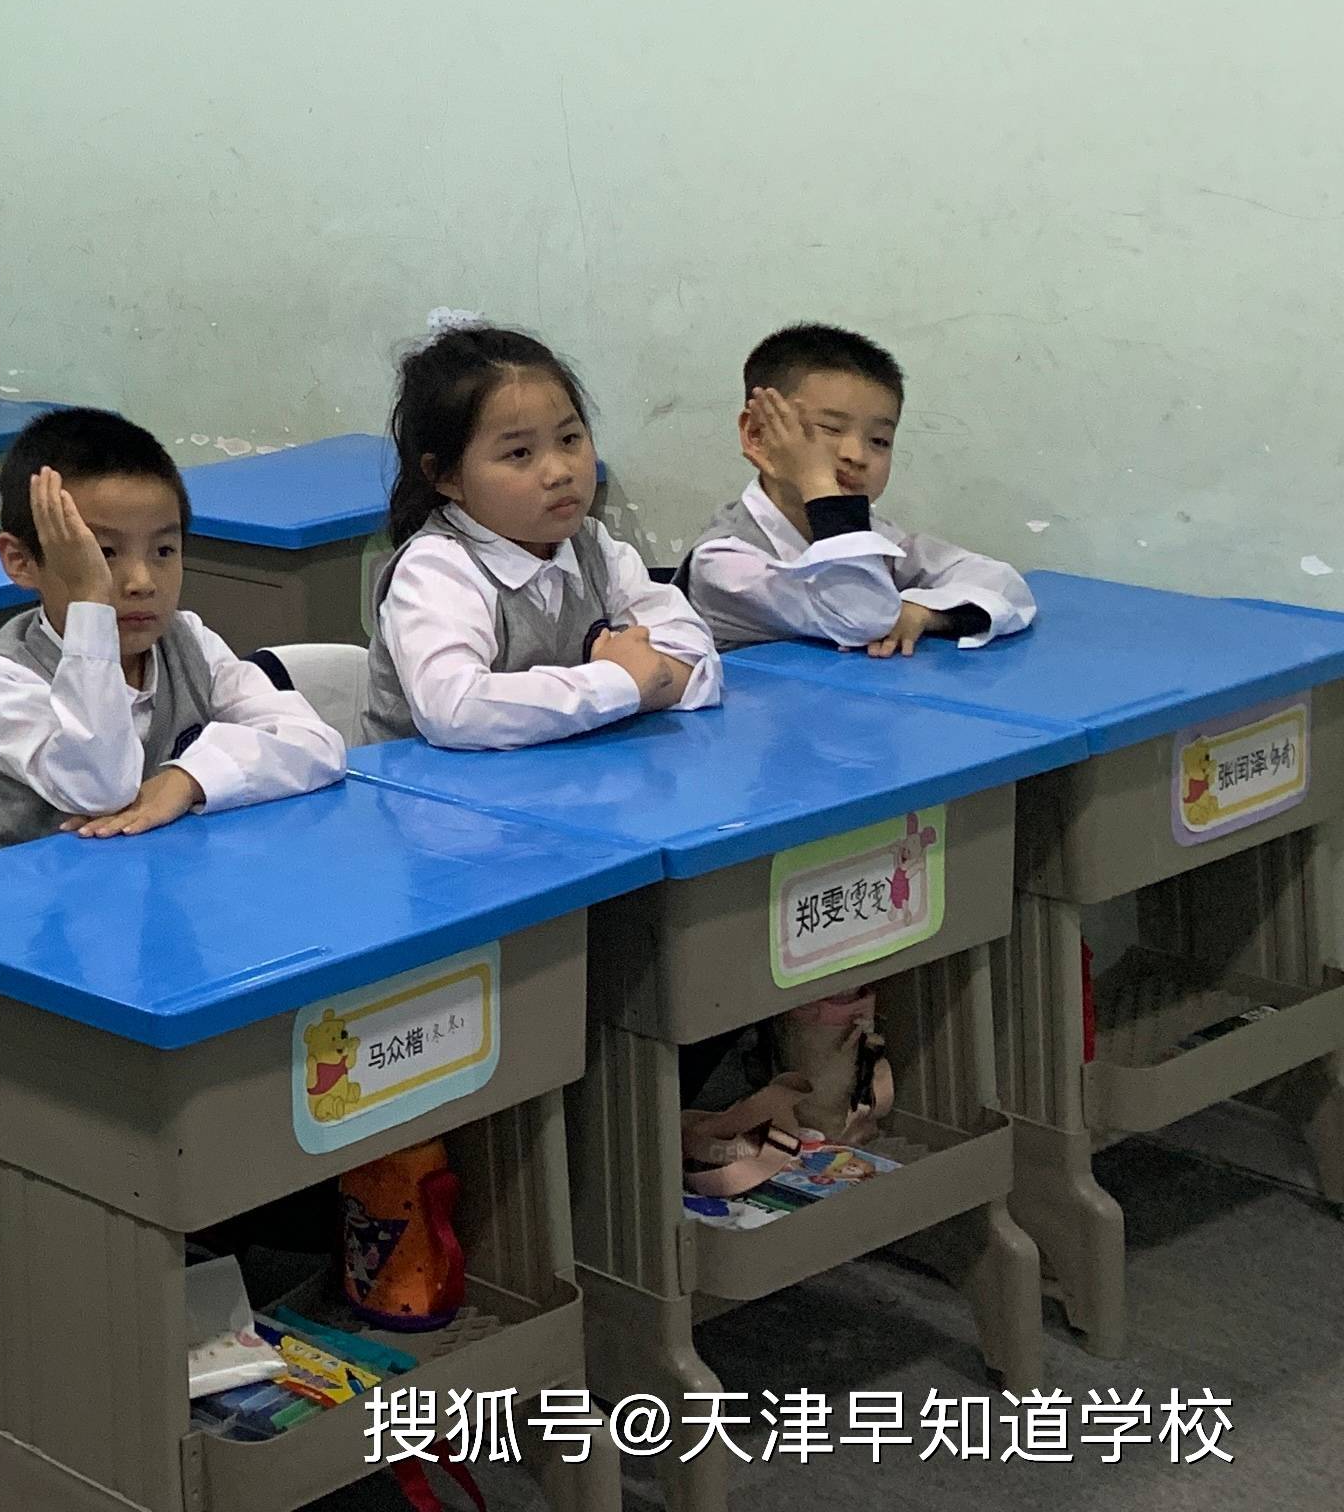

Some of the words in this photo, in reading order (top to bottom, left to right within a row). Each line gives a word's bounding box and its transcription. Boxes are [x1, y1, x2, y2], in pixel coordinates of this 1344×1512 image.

[796, 886, 844, 938] 郑雯
[368, 1027, 423, 1069] 马众楷
